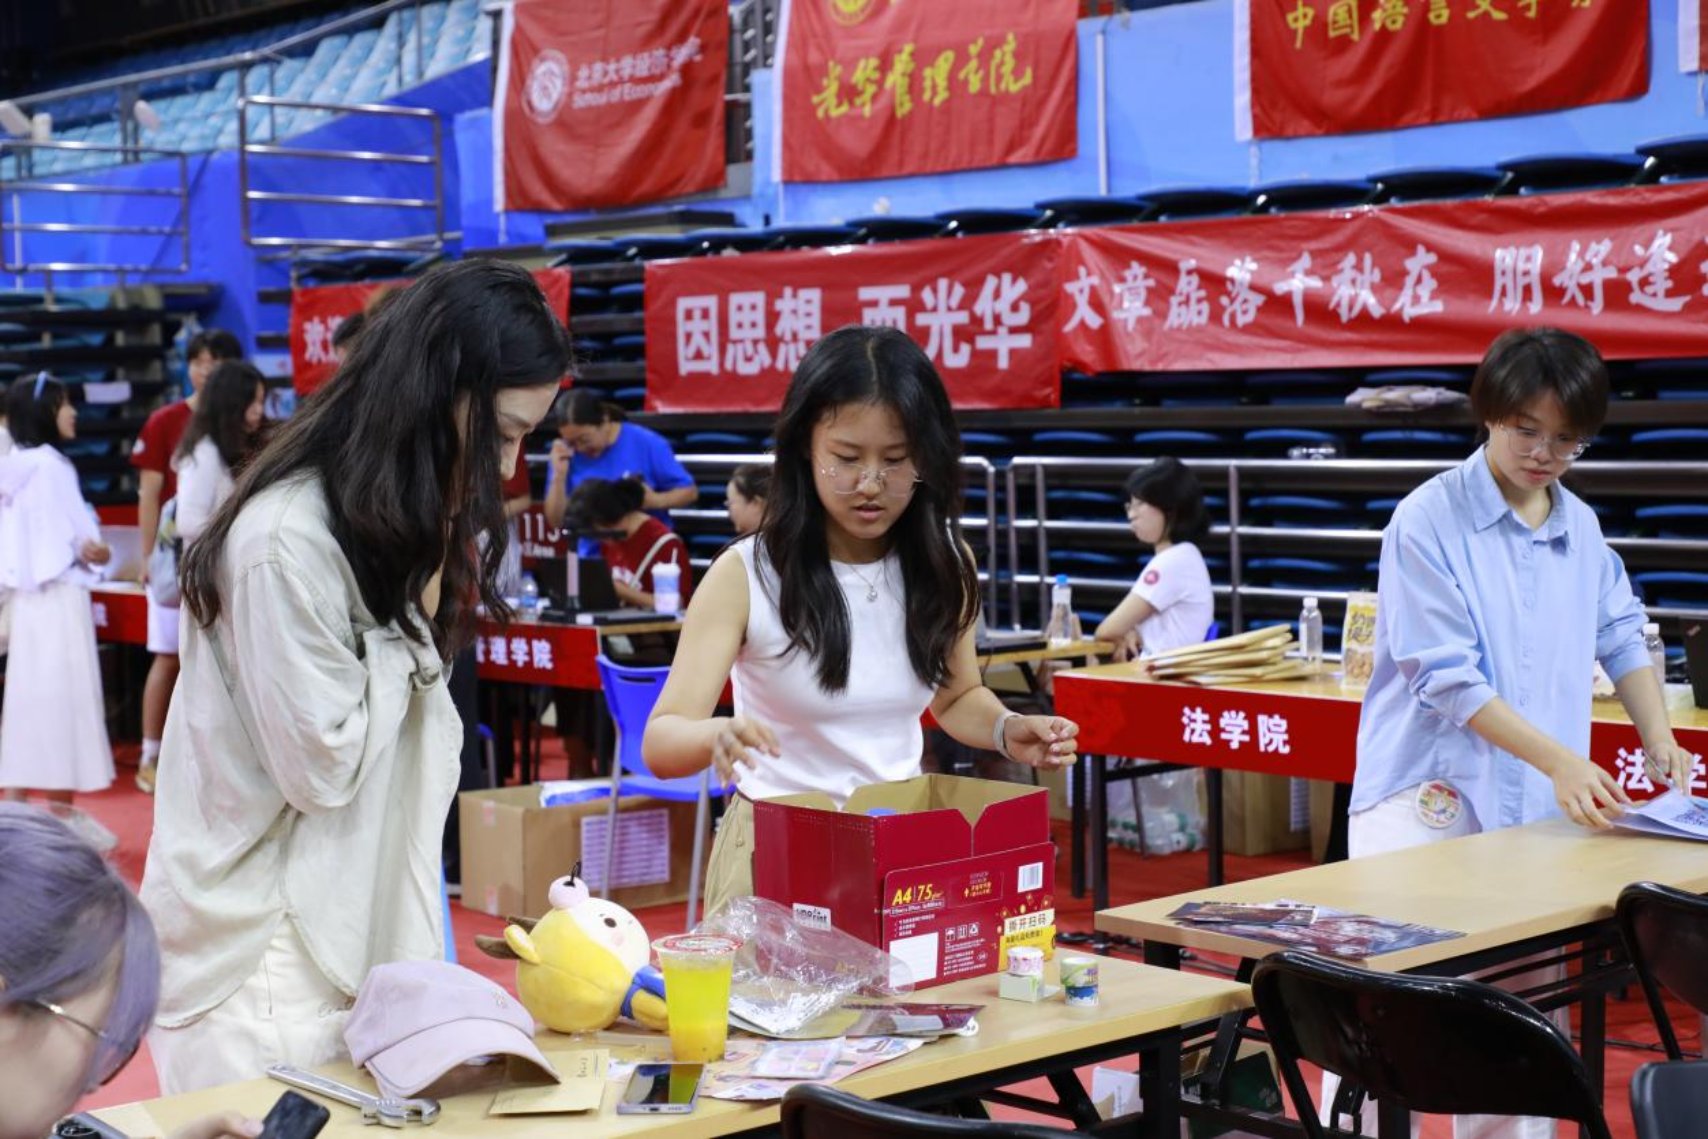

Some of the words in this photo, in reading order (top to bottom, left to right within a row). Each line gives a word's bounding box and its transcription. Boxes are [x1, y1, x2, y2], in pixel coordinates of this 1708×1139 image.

[1287, 0, 1592, 49] 中国语言文
[1060, 244, 1446, 335] 文章磊落千秋在
[1487, 229, 1708, 317] 朋好逢
[676, 286, 822, 378] 因思想
[1182, 706, 1291, 755] 法学院
[892, 886, 912, 906] A4
